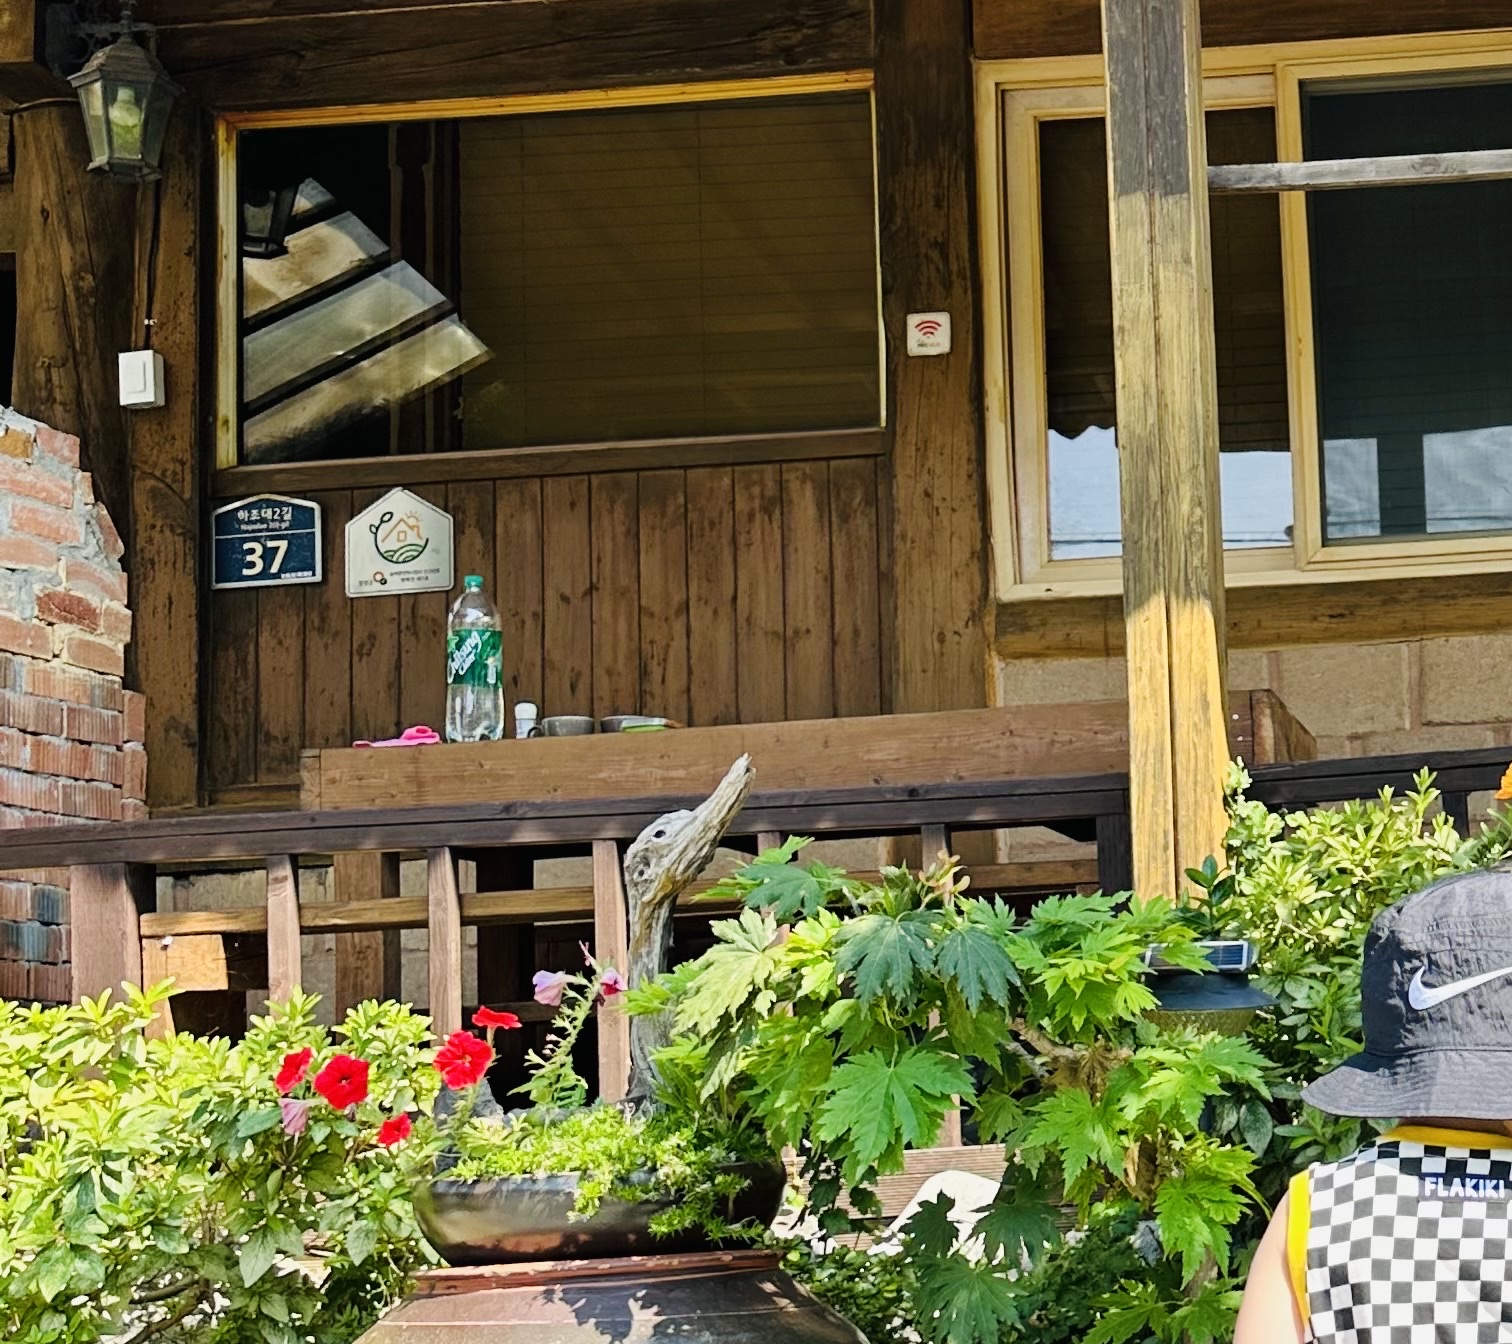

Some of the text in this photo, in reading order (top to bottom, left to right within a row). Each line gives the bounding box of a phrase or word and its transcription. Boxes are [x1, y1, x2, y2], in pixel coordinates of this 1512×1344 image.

[237, 506, 293, 522] 하조대2길
[241, 539, 289, 577] 37
[1424, 1176, 1506, 1199] FLAKIKI
